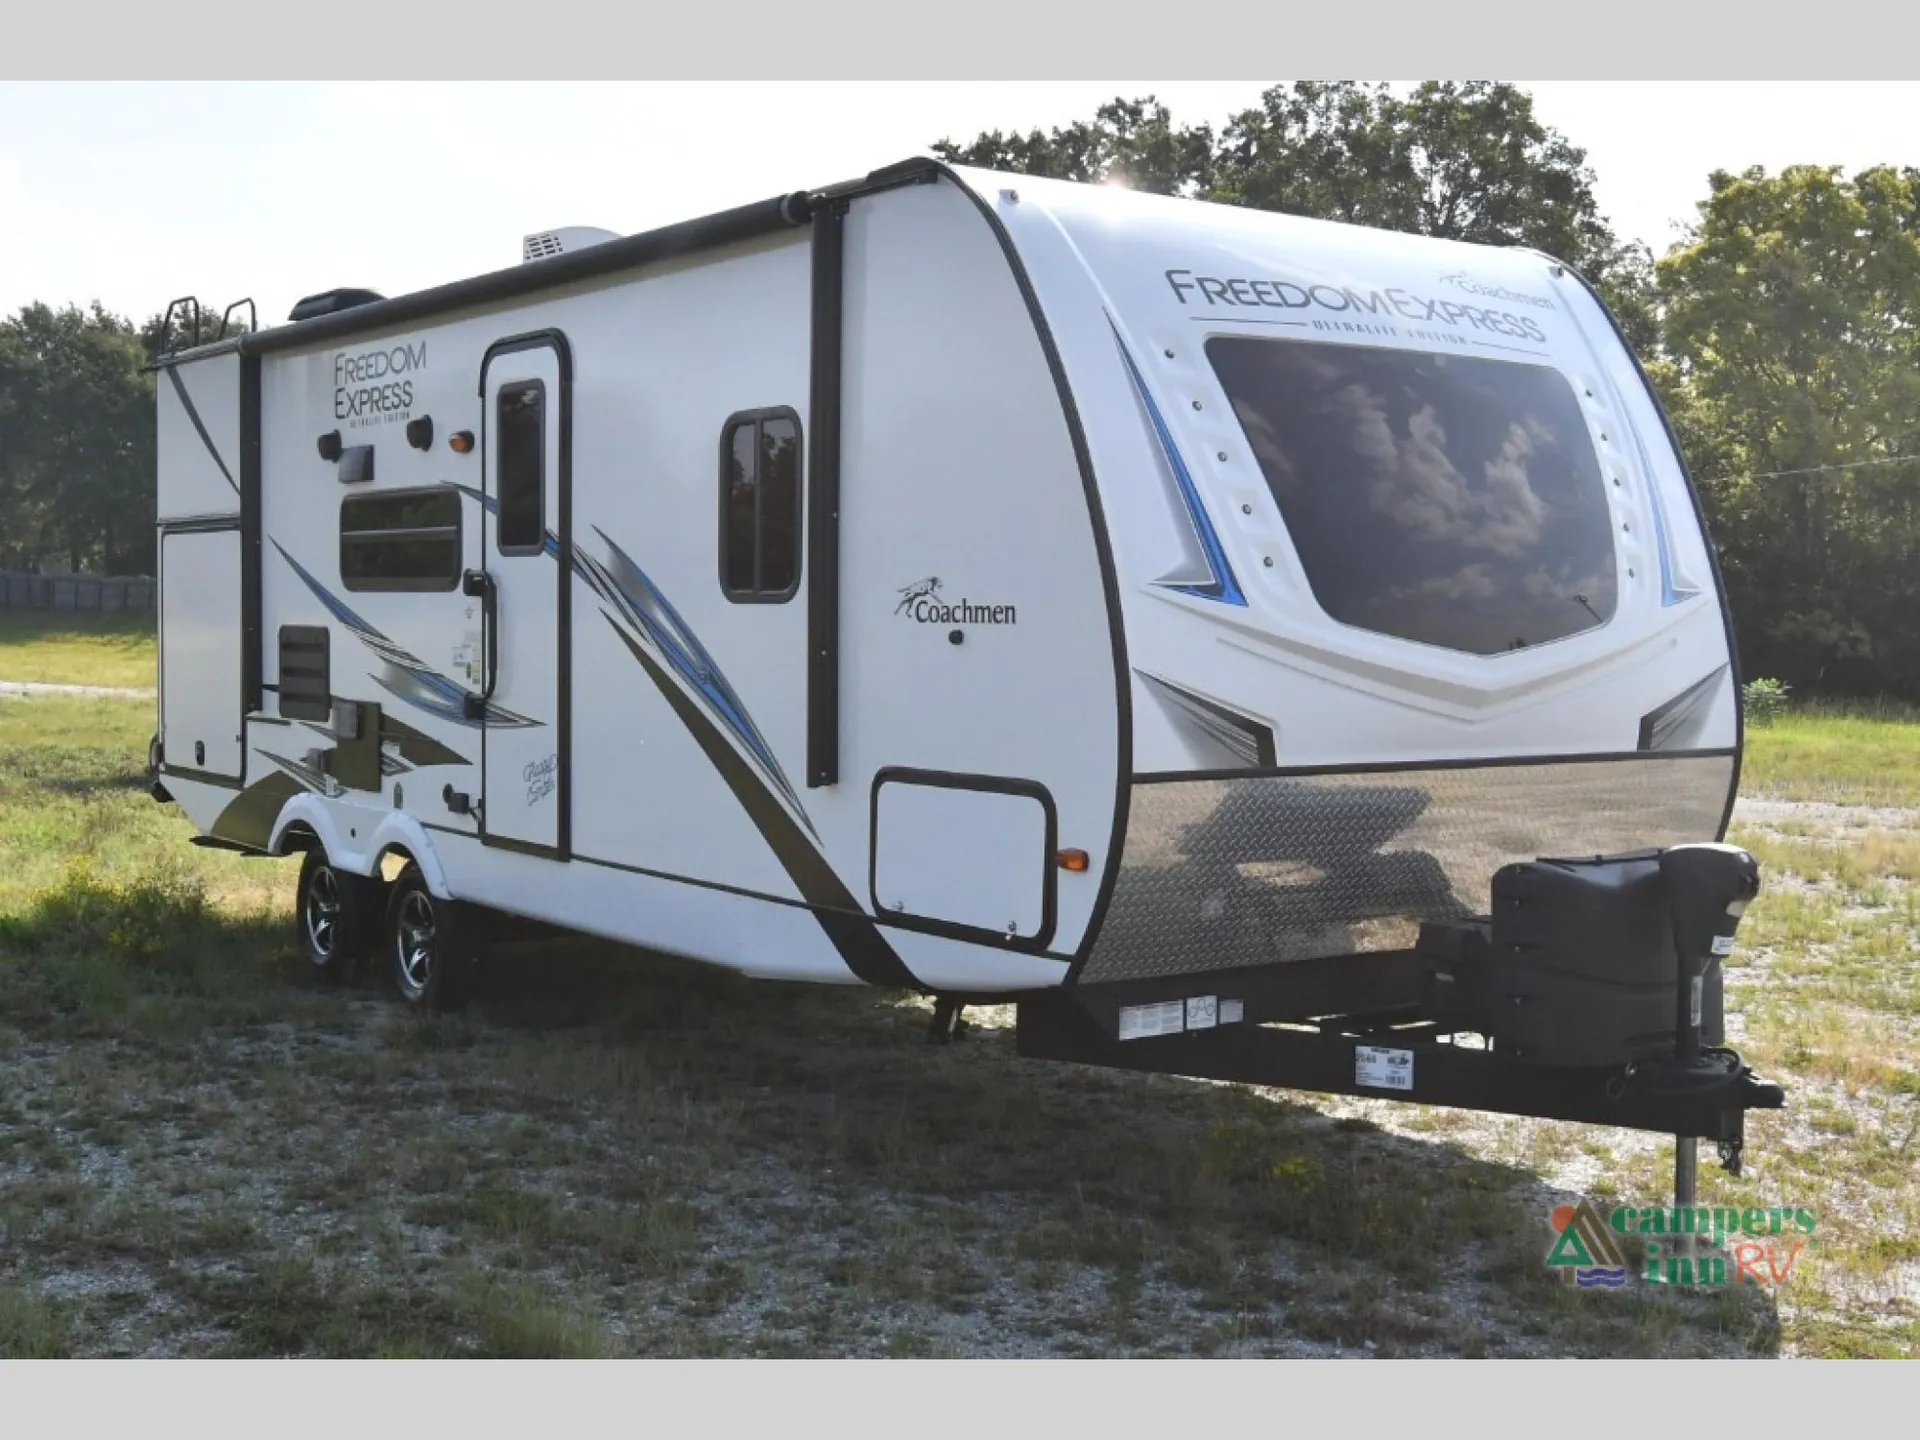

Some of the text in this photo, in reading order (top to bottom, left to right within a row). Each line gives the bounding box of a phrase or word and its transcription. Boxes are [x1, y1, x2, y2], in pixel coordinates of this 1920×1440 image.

[334, 340, 427, 386] FREEDOM
[334, 380, 414, 420] EXPRESS
[915, 597, 1017, 624] Coachmen
